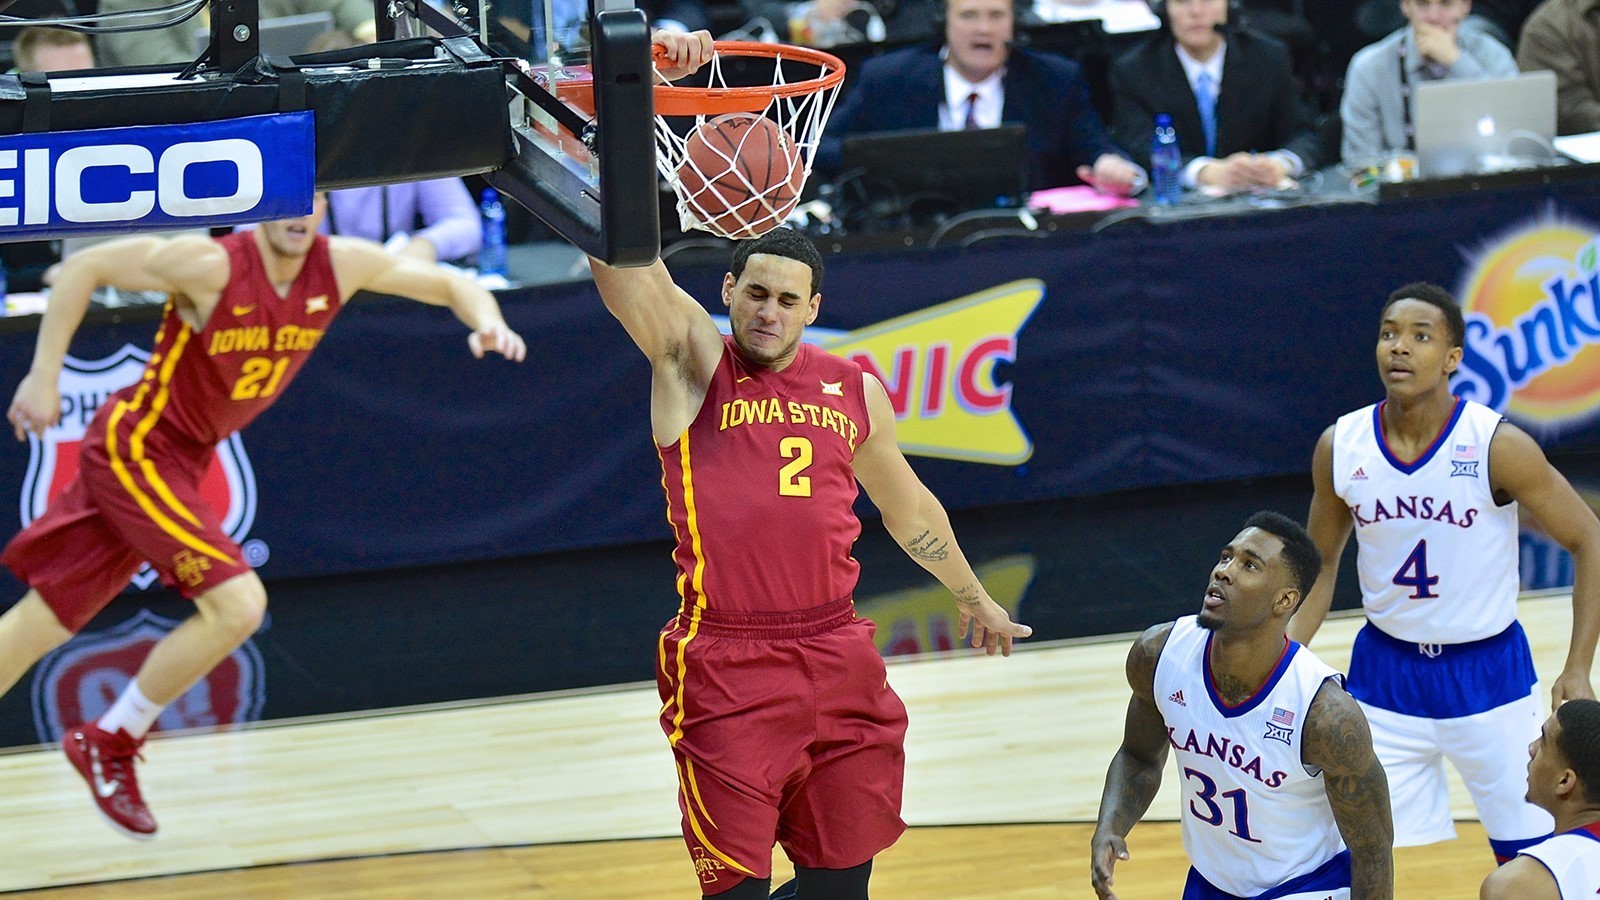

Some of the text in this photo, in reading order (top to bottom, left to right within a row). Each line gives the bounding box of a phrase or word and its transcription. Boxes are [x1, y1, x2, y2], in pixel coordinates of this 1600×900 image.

[208, 326, 269, 356] IOWA
[231, 357, 290, 400] 21
[719, 397, 859, 454] IOWA STATE
[778, 436, 814, 497] 2
[1350, 495, 1479, 528] KANSAS
[1392, 538, 1440, 599] 4
[1167, 725, 1288, 788] KANSAS
[1183, 766, 1262, 843] 31
